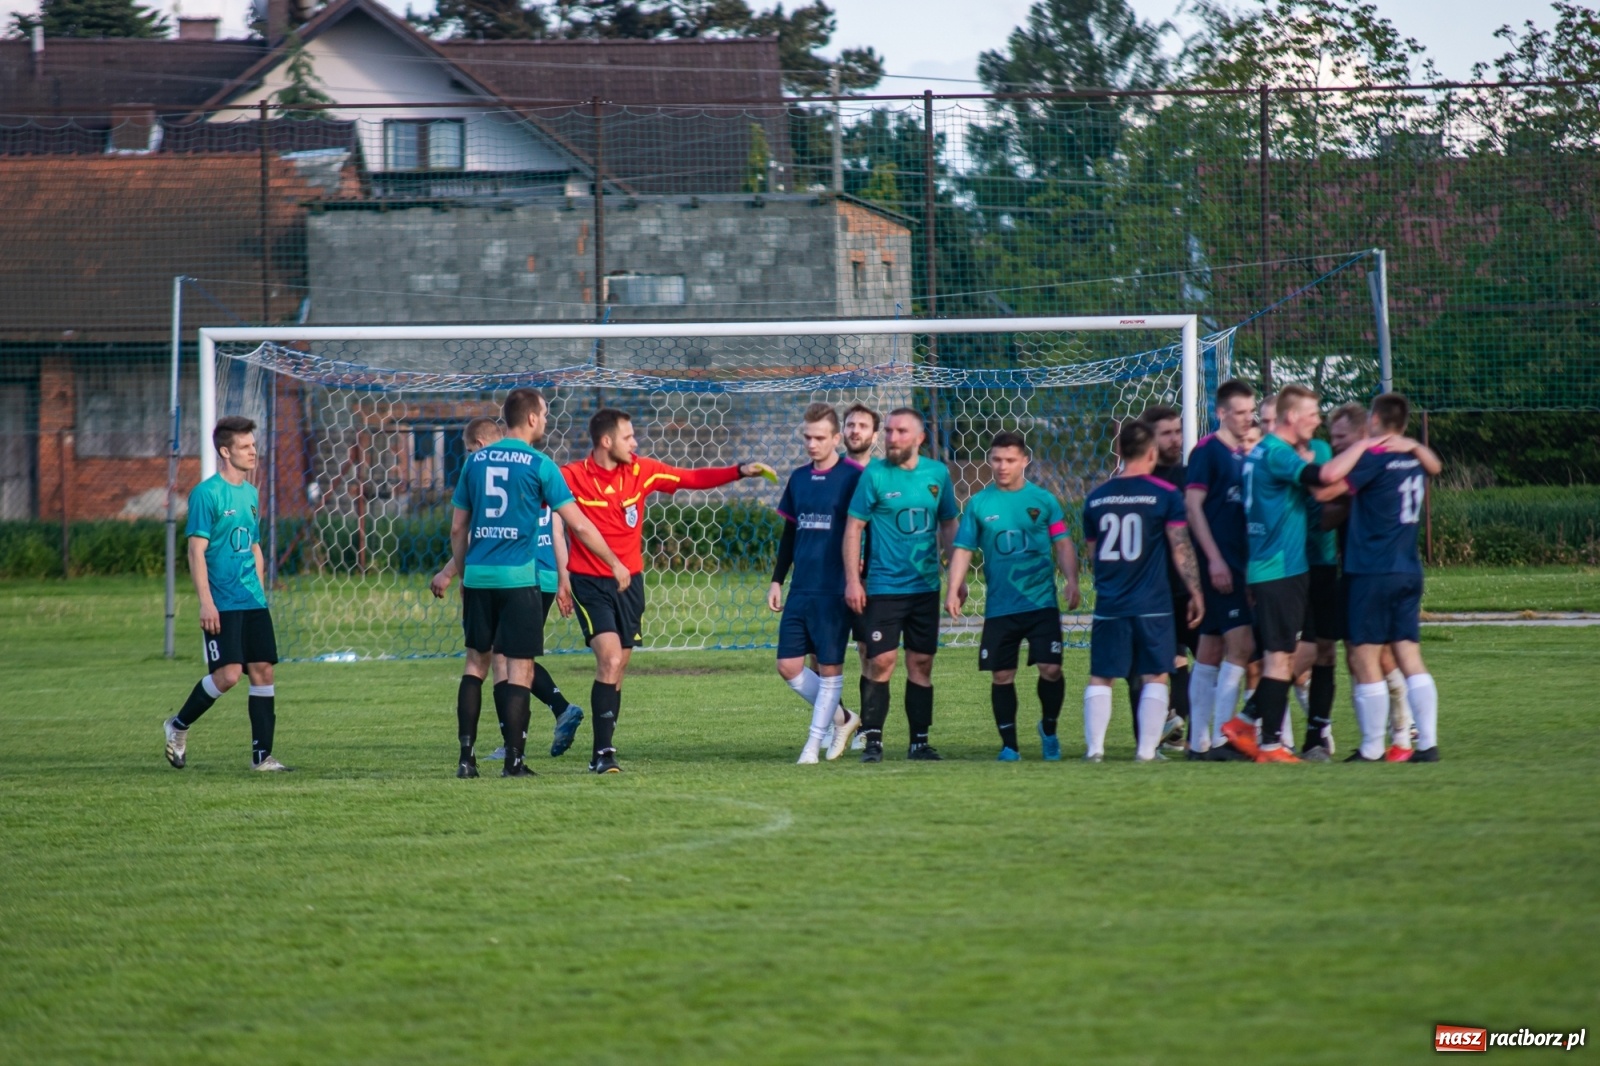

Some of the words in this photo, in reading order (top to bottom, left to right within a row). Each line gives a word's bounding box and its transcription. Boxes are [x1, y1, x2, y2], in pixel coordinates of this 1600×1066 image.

[489, 450, 533, 466] CZARNI
[485, 466, 509, 518] 5
[1397, 474, 1425, 524] 11
[1098, 512, 1143, 562] 20
[208, 639, 221, 662] 8
